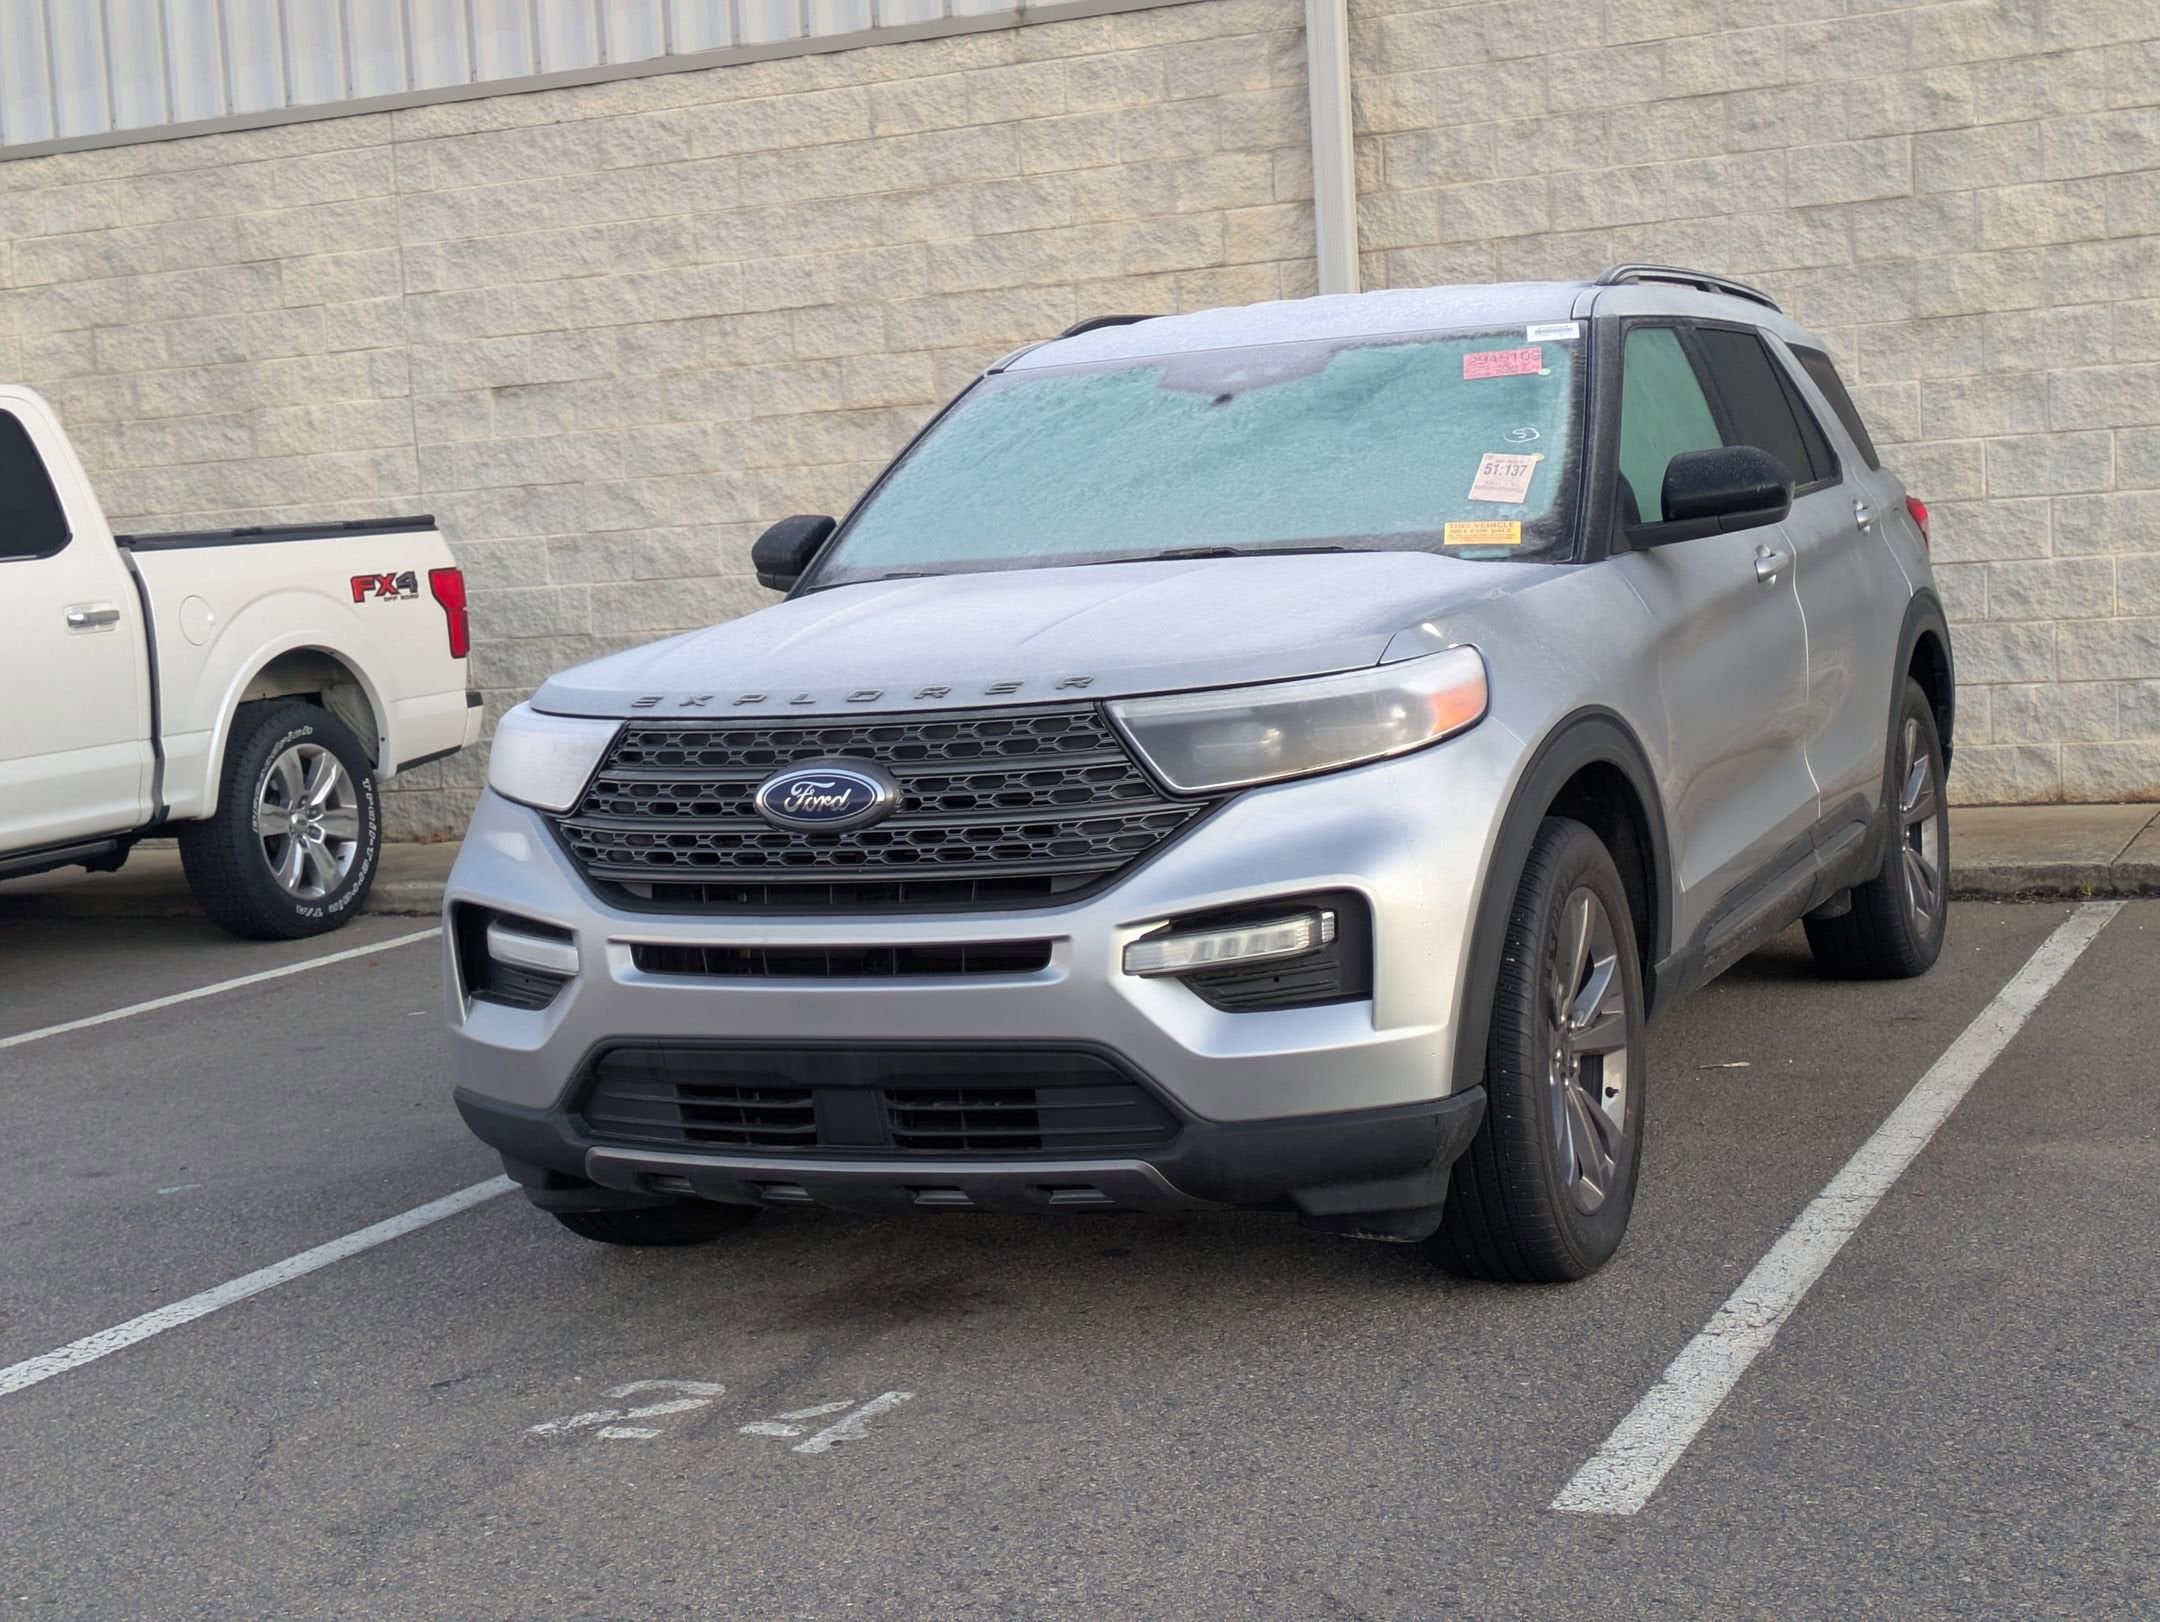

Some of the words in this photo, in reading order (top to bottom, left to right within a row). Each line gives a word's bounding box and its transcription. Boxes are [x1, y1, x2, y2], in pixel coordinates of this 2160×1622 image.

[350, 571, 418, 603] FX4
[631, 675, 1095, 707] EXPLORER
[784, 781, 852, 813] Ford
